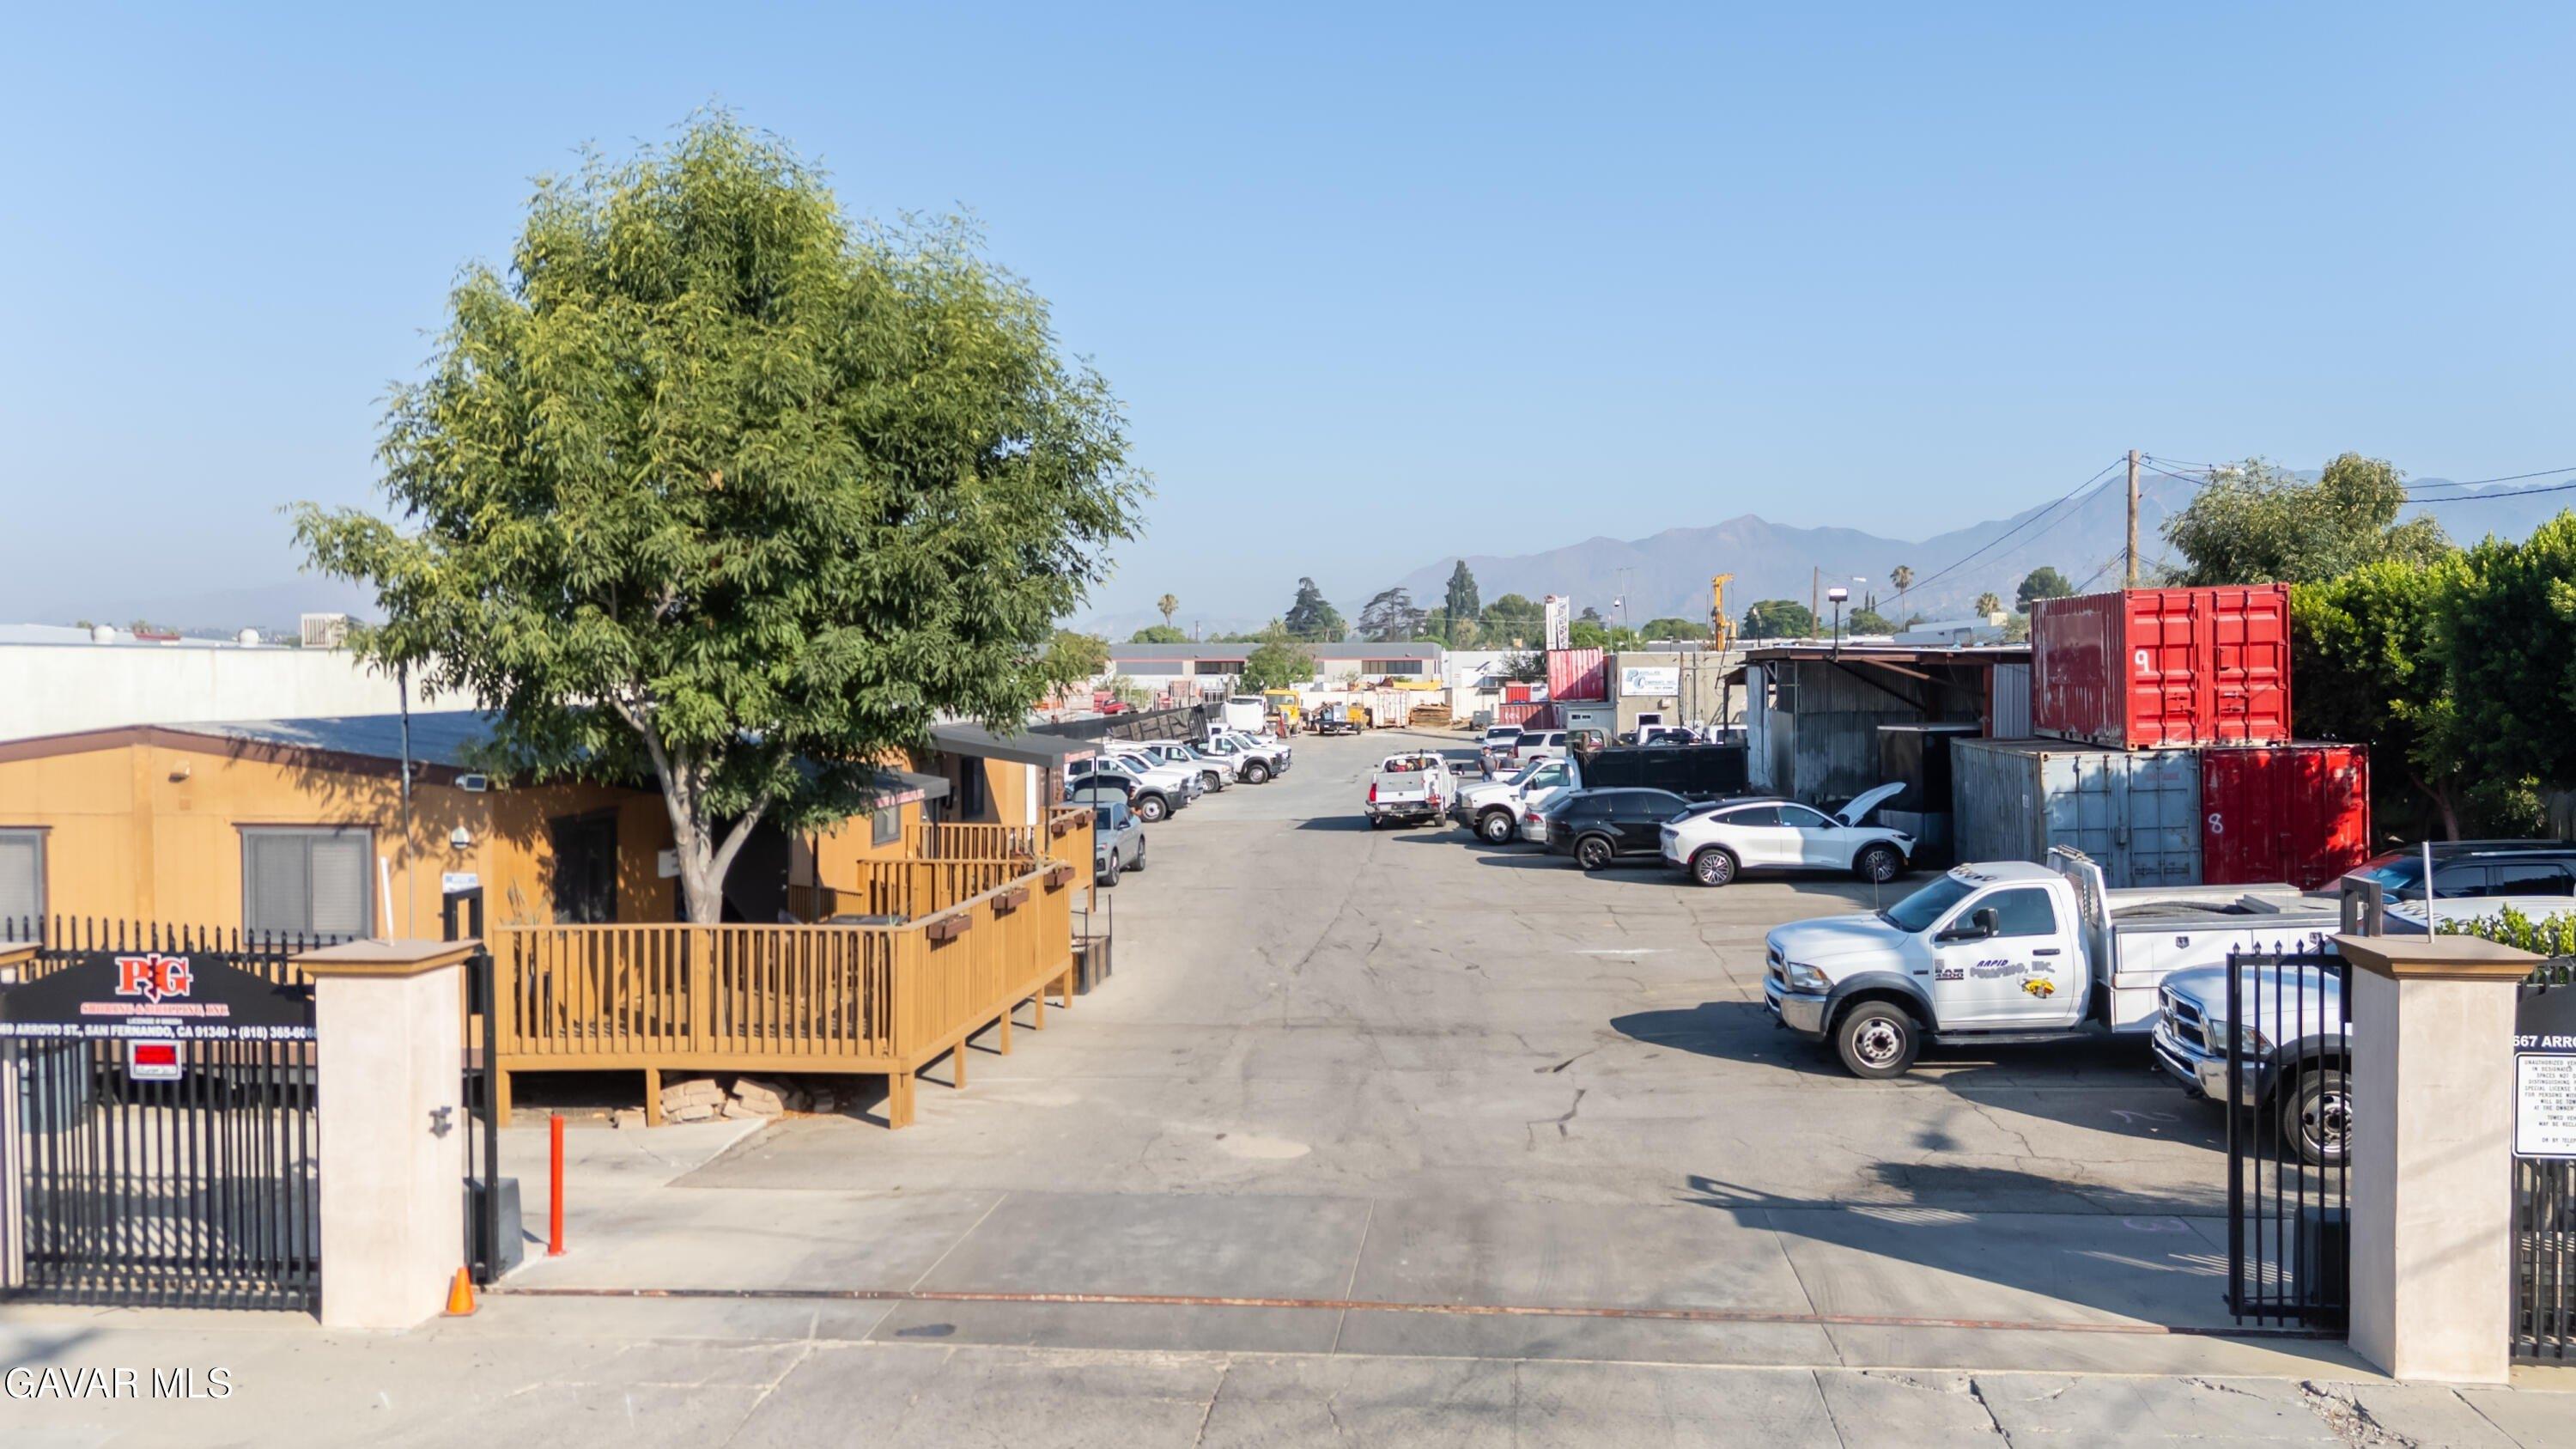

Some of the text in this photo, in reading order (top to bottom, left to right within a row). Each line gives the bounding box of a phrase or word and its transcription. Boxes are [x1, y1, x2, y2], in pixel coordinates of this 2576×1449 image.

[2135, 649, 2149, 673] 9
[2208, 813, 2223, 834] 8
[15, 1023, 62, 1036] ARROYO
[85, 1025, 109, 1037] SAN
[110, 1025, 175, 1038] FERNANDO,
[177, 1026, 193, 1038] CA
[195, 1026, 229, 1038] 91340
[239, 1026, 267, 1040] (818)
